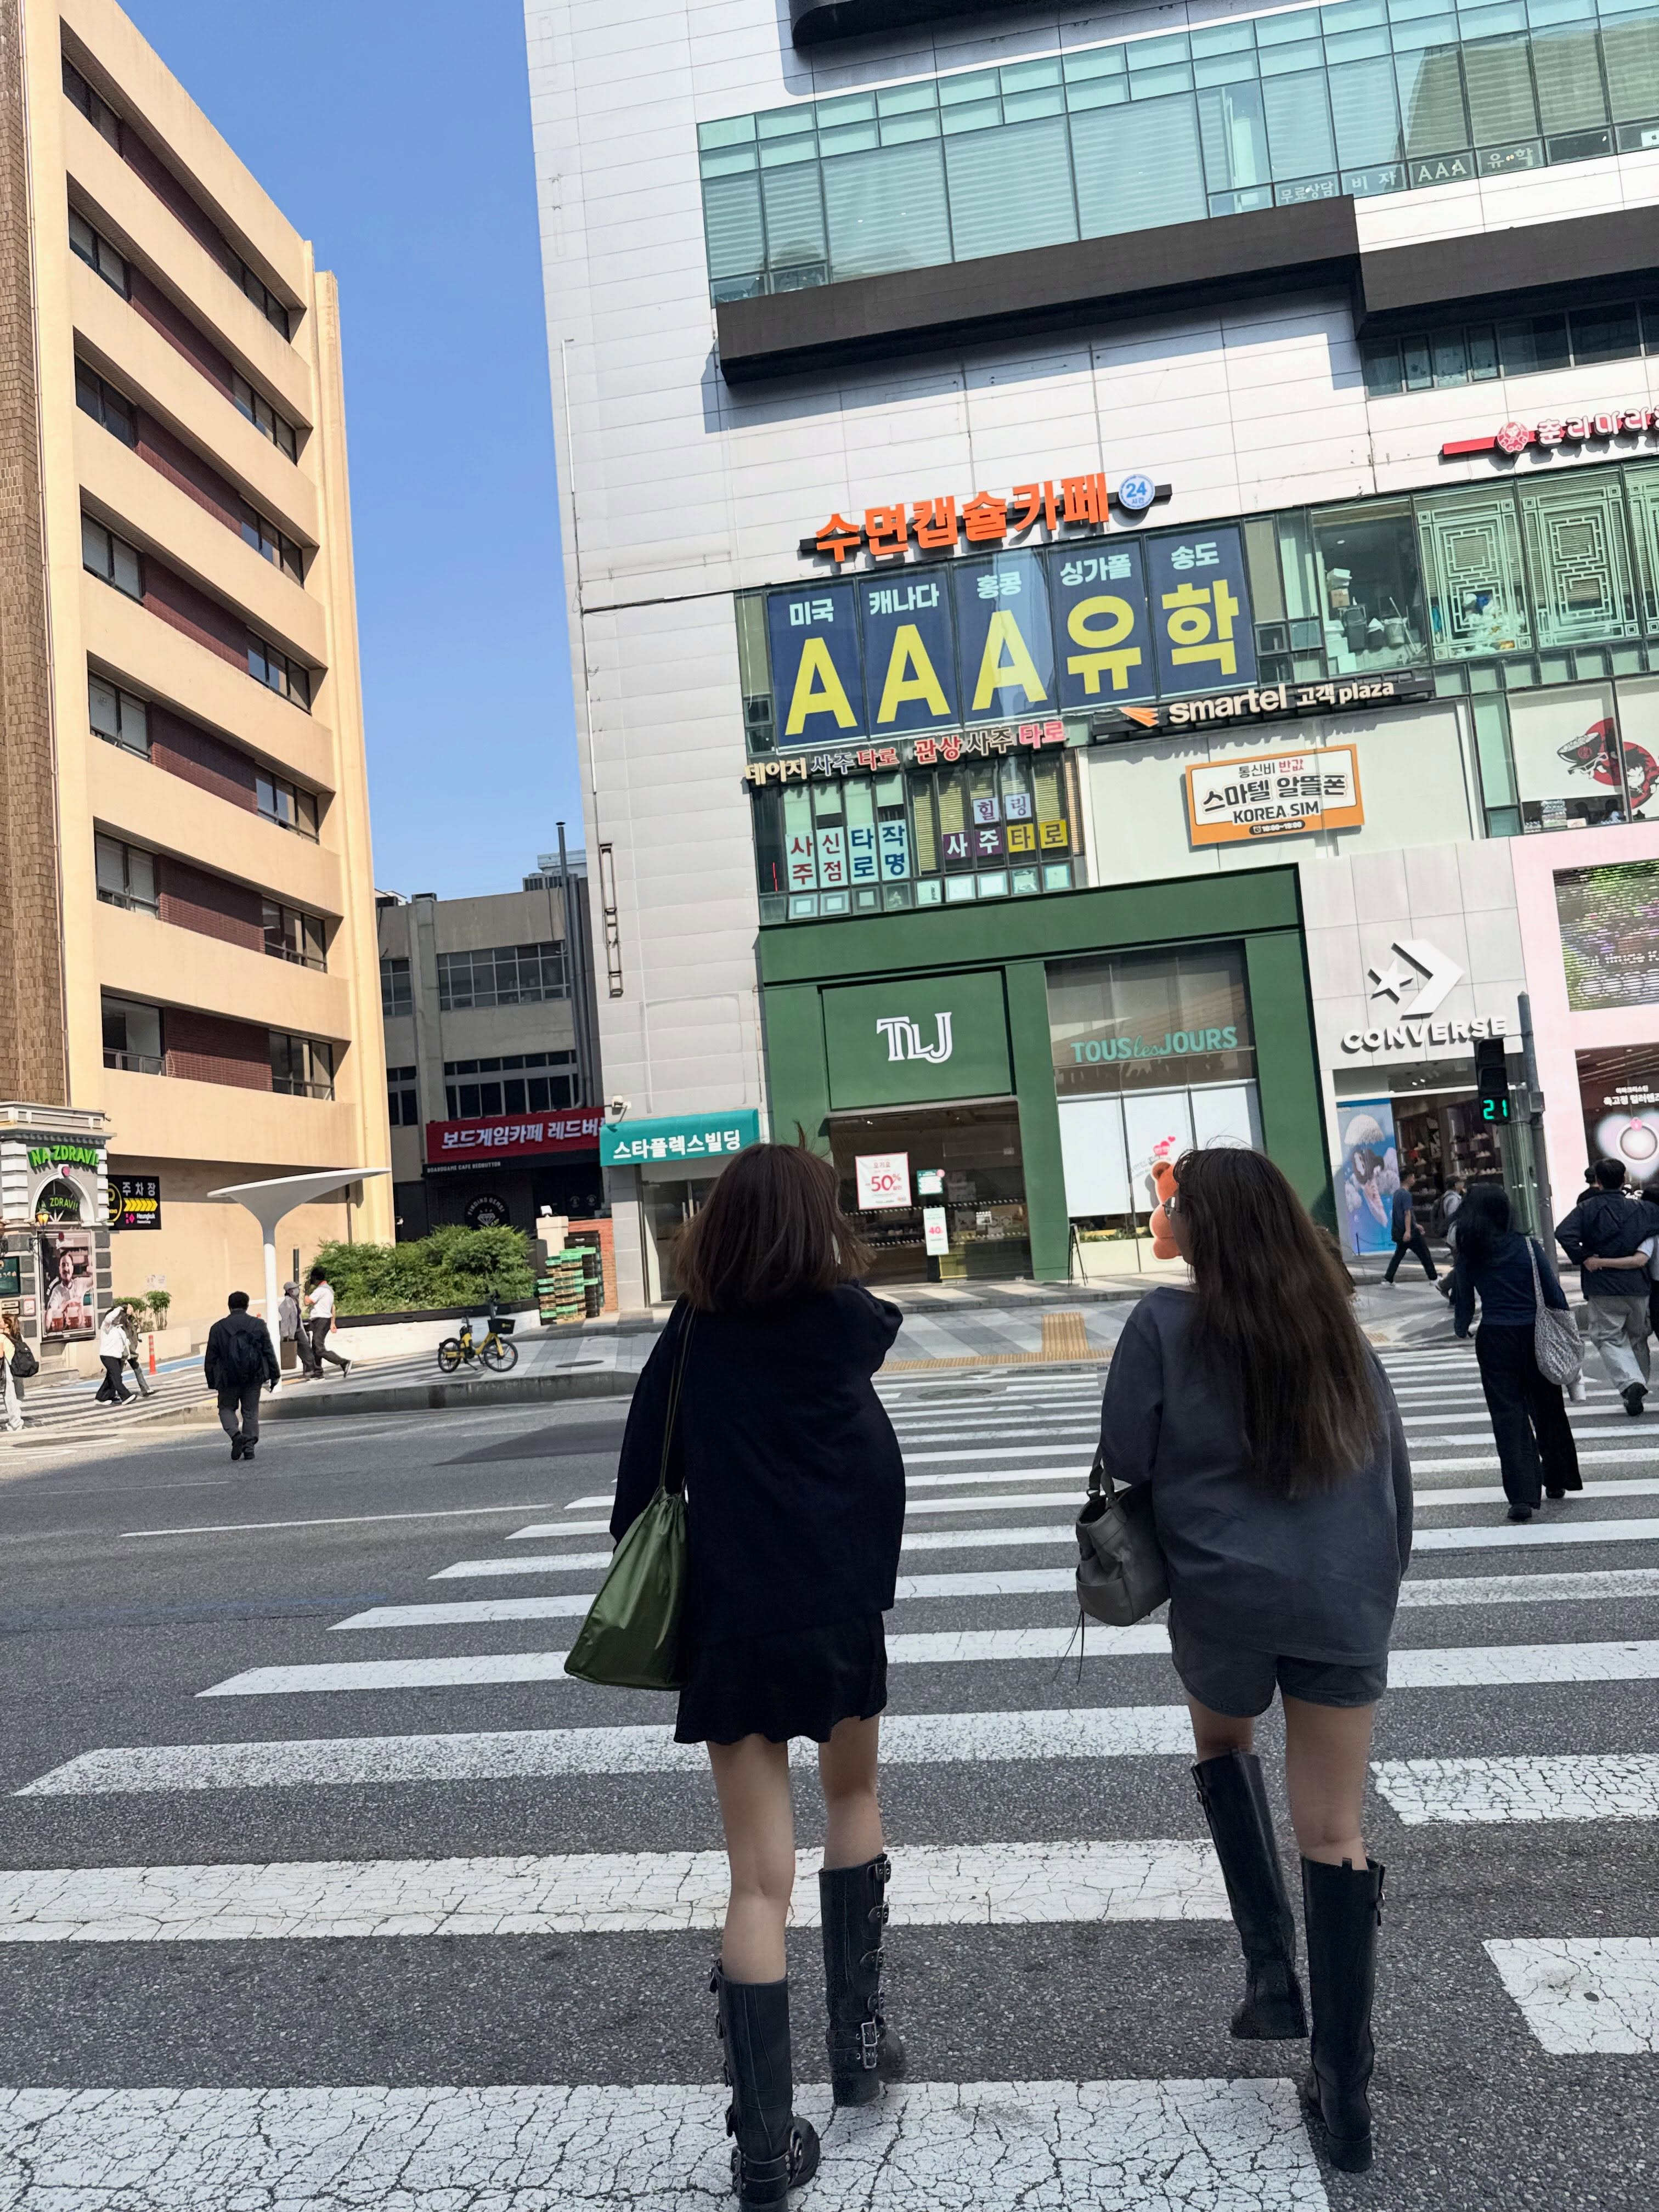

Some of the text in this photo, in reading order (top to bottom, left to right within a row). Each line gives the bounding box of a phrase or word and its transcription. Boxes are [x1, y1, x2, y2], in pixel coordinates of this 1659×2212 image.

[1280, 180, 1334, 203] 무료상담
[1418, 159, 1468, 182] AAA
[1537, 404, 1659, 446] 춘리마라
[1126, 481, 1147, 498] 24
[816, 472, 1109, 562] 수면캡슐카페
[789, 542, 1220, 626] 미국 캐나다 홍콩 싱가폴 송도
[1169, 681, 1395, 725] smartel 고객 plaza
[913, 720, 1067, 765] 관상 사주 타로
[744, 747, 900, 785] 데이지 사주 타로
[1238, 758, 1305, 779] 통신비 반값
[1203, 774, 1346, 812] 스마텔 알뜰폰
[1233, 800, 1319, 824] KOREA SIM
[946, 822, 1065, 857] 사주 타로
[876, 1011, 954, 1064] TLJ
[1342, 1016, 1508, 1052] CONVERSE
[1483, 1099, 1508, 1120] 21
[441, 1122, 544, 1149] 보드게임카페
[613, 1129, 741, 1160] 스타플렉스빌딩
[31, 1144, 99, 1167] NA ZDRAVI!
[122, 1181, 156, 1197] 주차장
